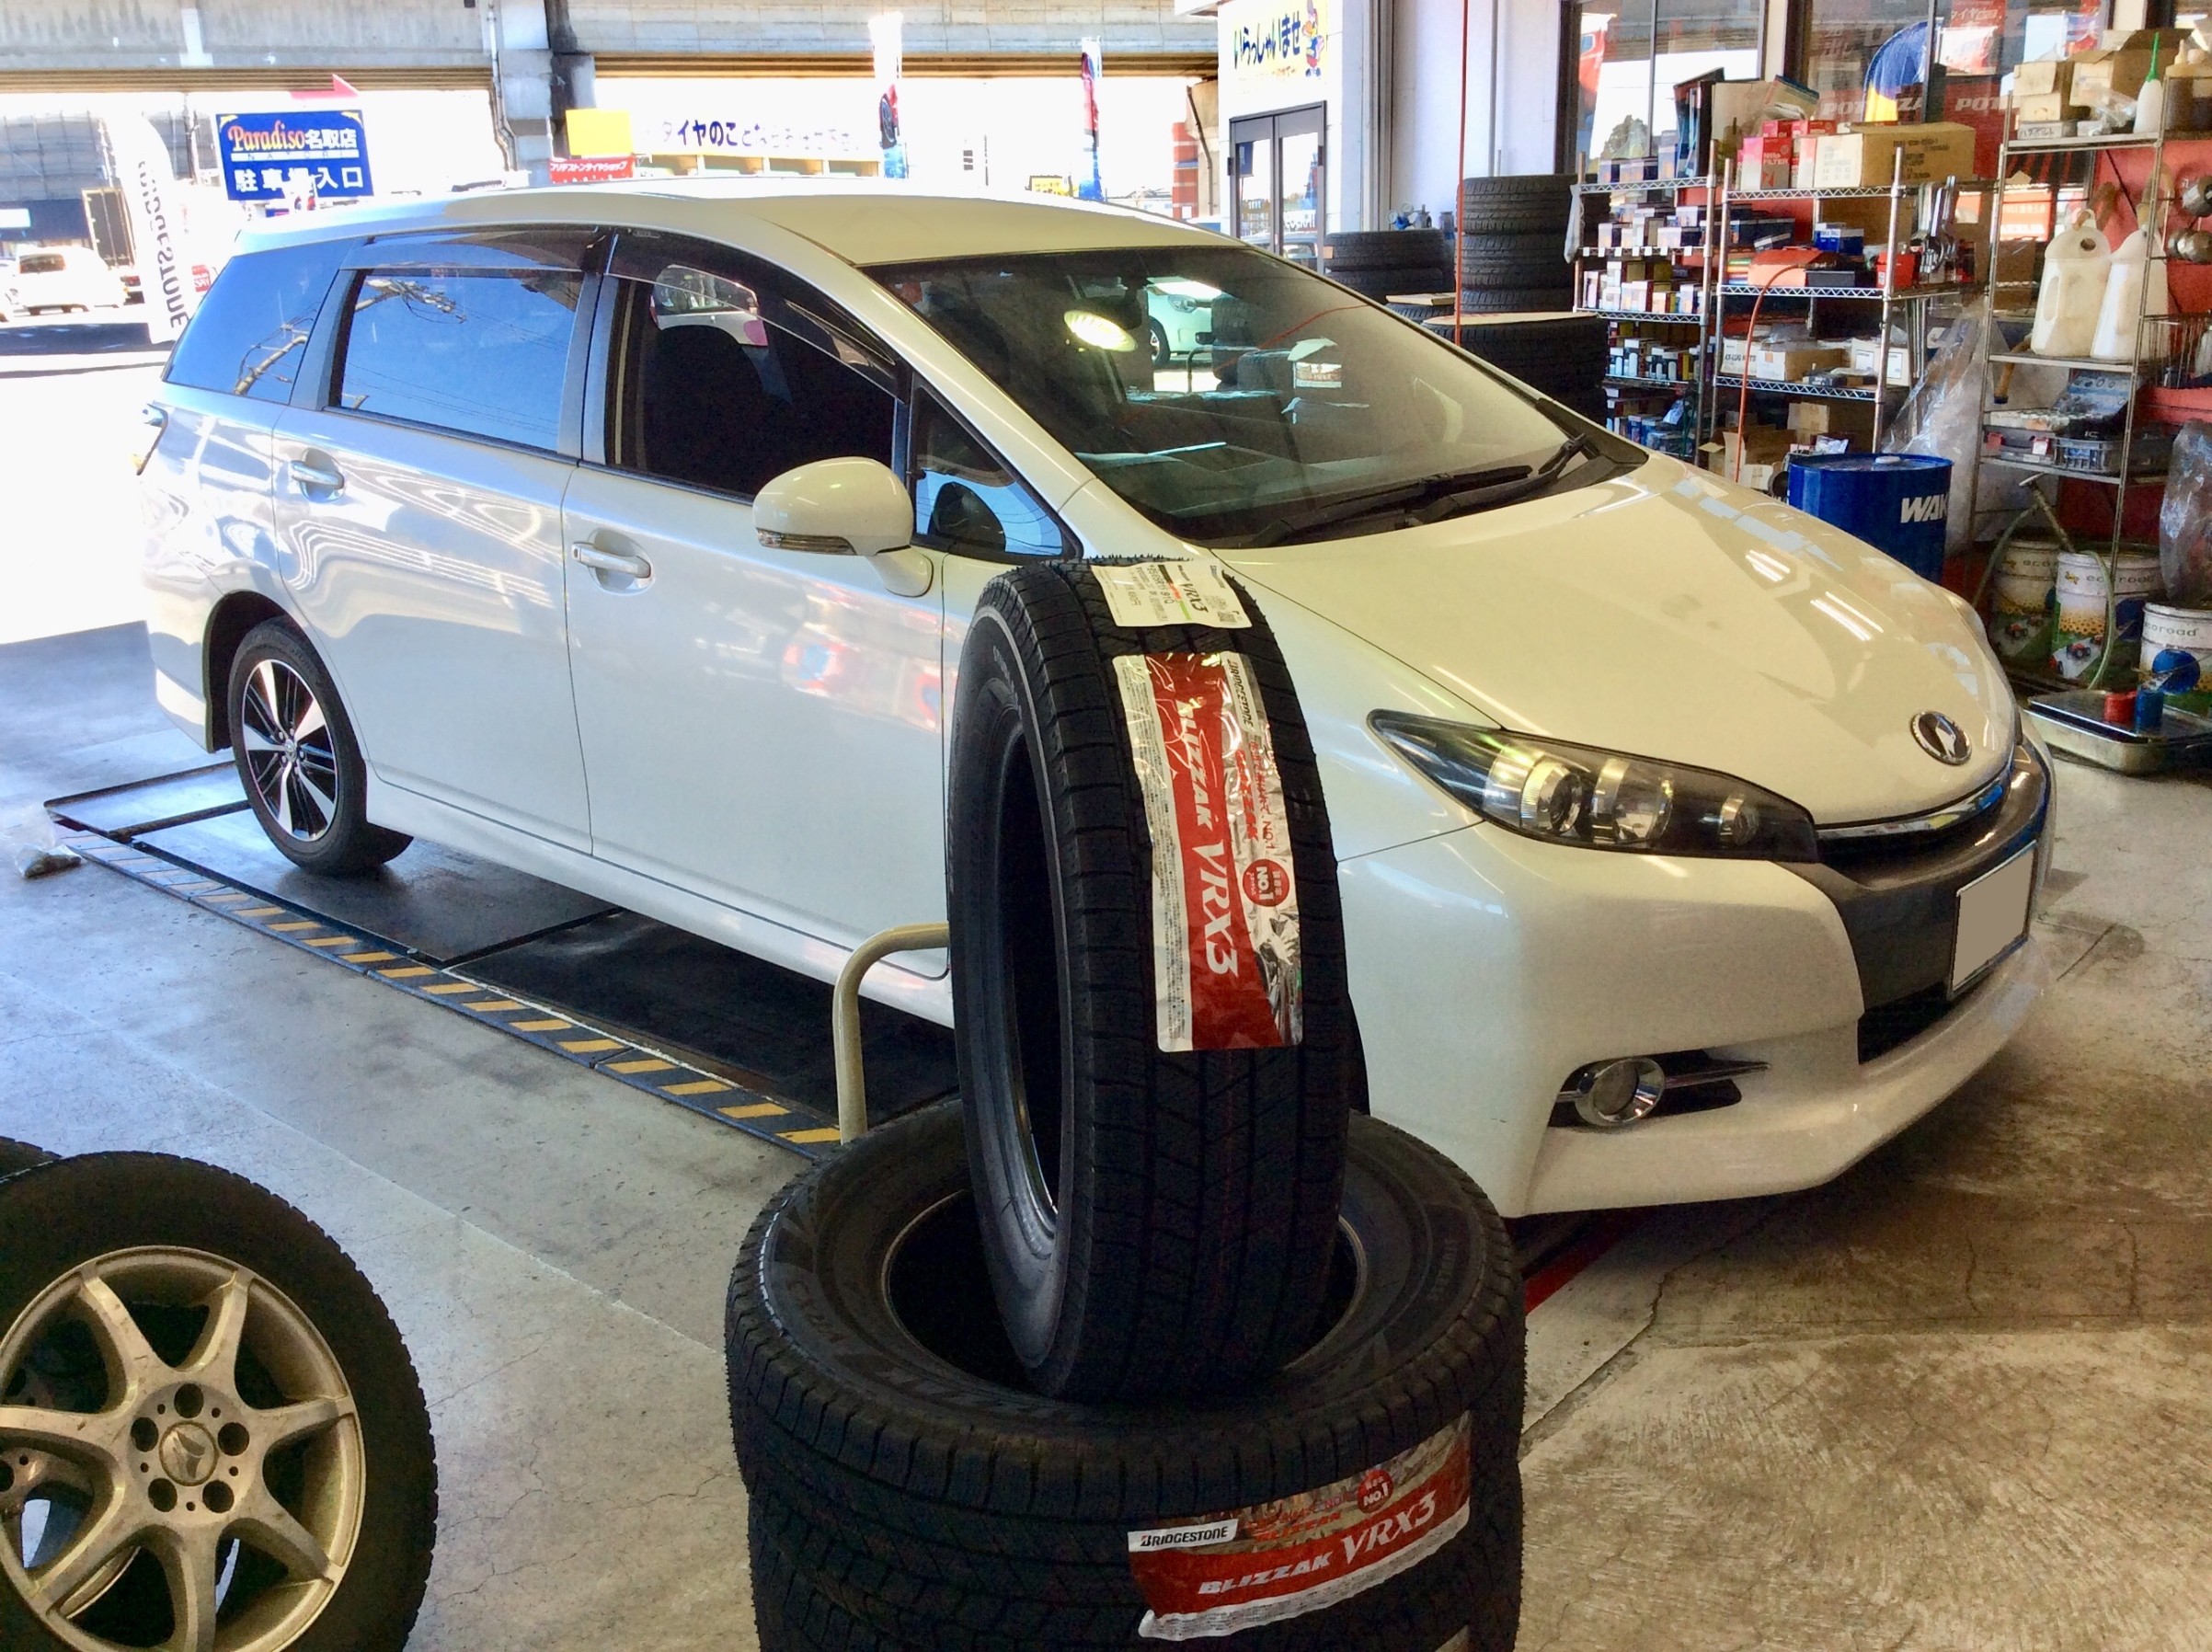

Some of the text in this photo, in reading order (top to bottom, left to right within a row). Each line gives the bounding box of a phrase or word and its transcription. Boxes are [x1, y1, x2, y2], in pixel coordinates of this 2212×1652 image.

[227, 120, 358, 152] Paradiso 名取店
[1175, 699, 1239, 979] BLIZZAK VRX3
[1255, 866, 1274, 901] NO.1
[1363, 1482, 1390, 1508] NO.1
[1140, 1525, 1229, 1548] BRIDGESTONE
[1198, 1551, 1334, 1595] BLIZZAK
[1341, 1489, 1437, 1565] VRX3
